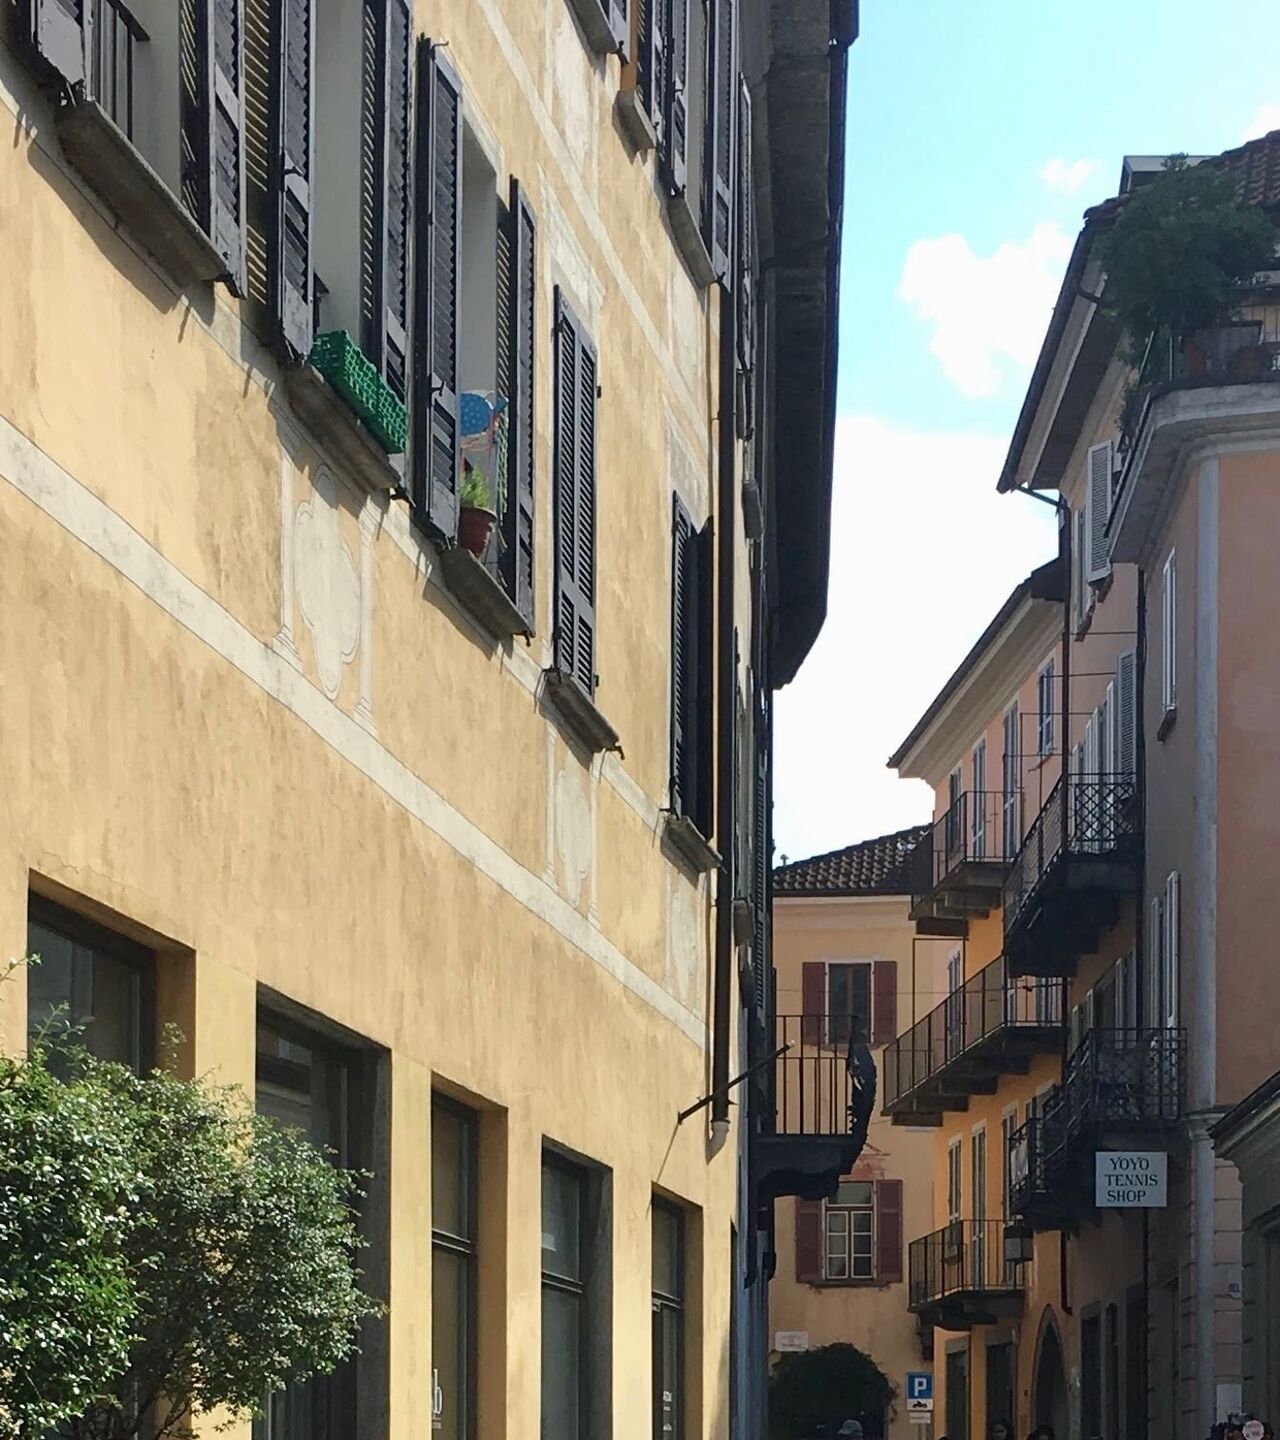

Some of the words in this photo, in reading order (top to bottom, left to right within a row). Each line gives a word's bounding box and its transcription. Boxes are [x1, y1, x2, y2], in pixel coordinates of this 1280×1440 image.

[1110, 1157, 1150, 1171] YOYO
[1104, 1174, 1158, 1187] TENNIS
[1107, 1190, 1146, 1203] SHOP
[914, 1377, 927, 1397] P
